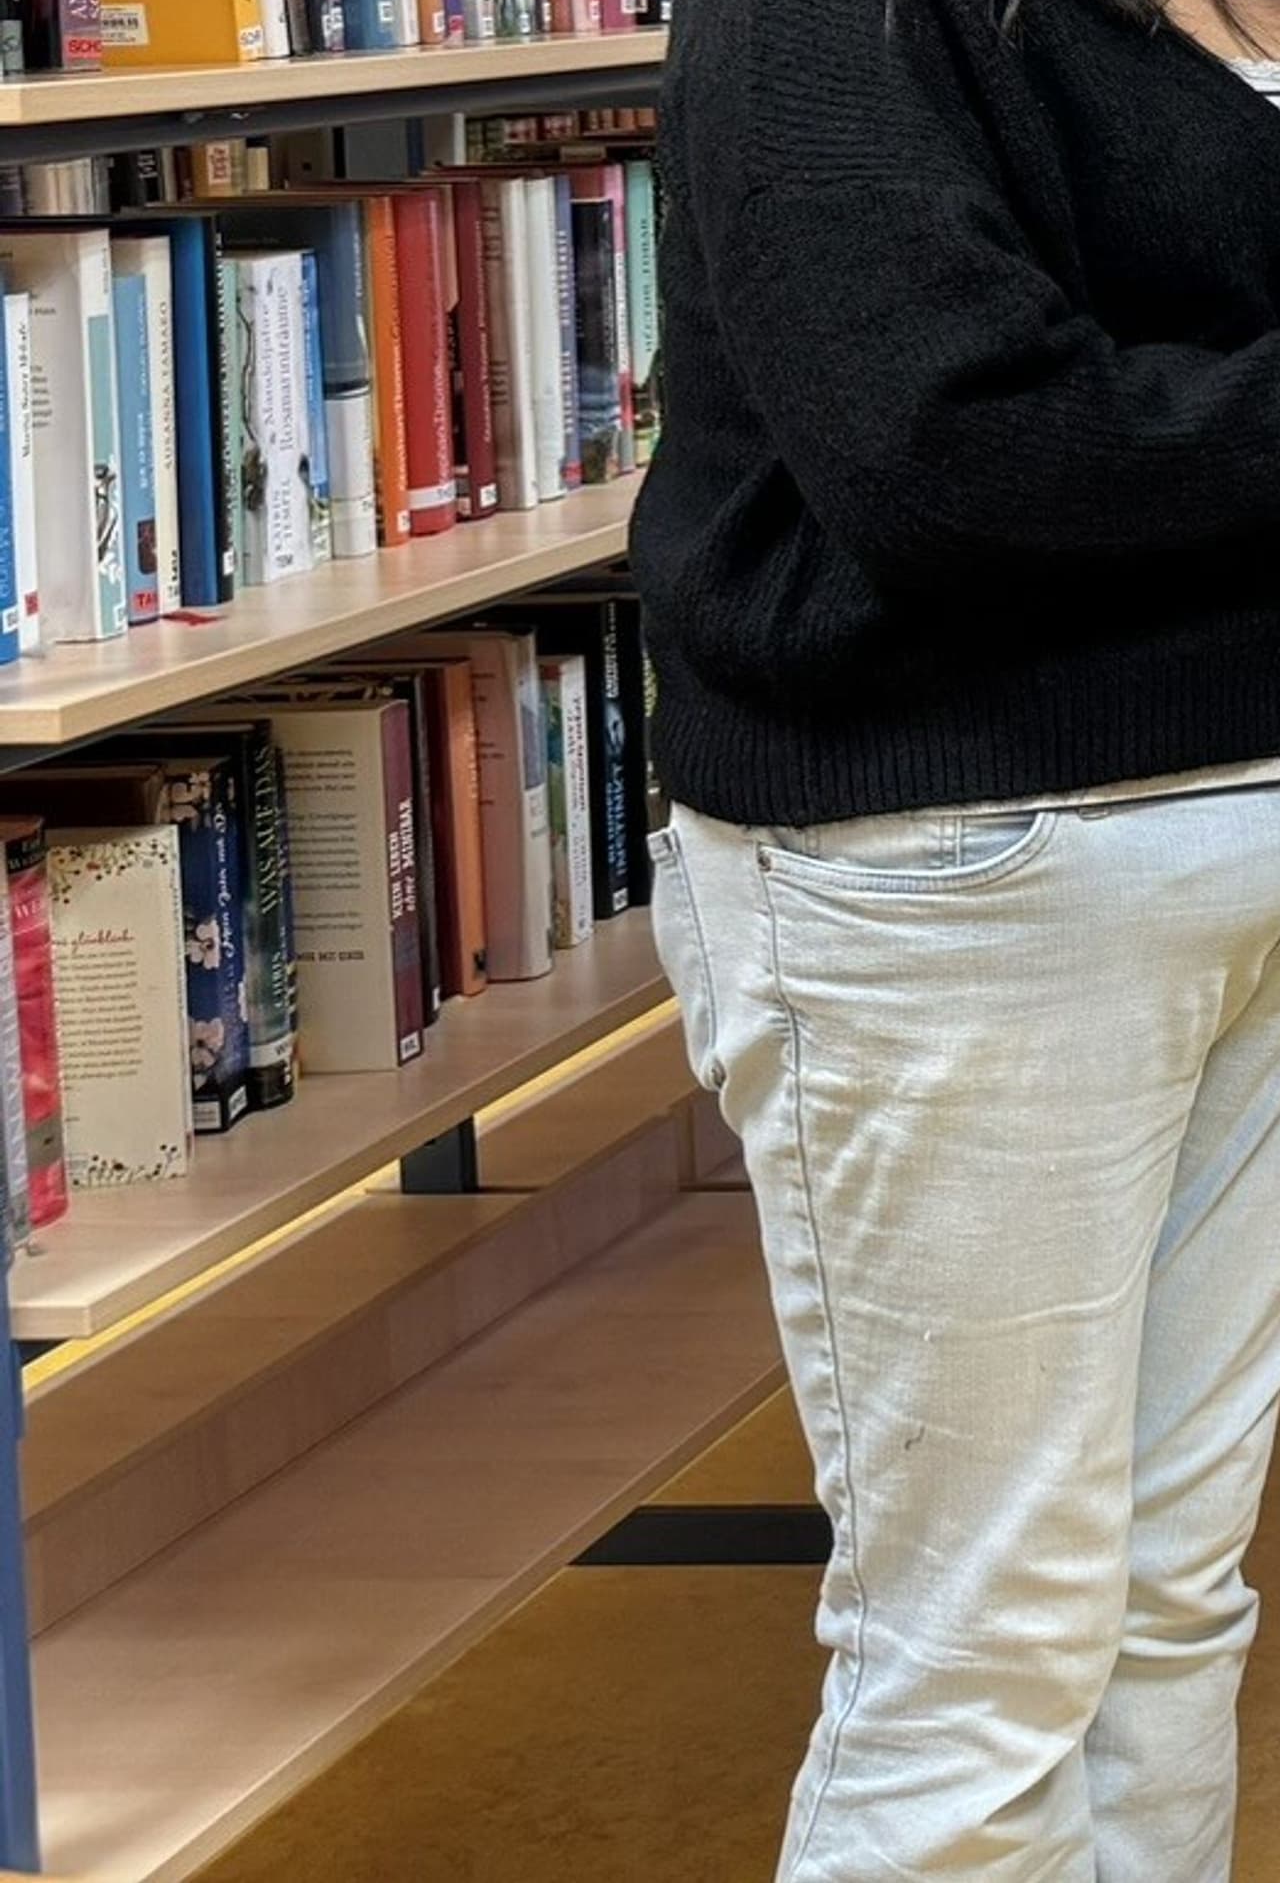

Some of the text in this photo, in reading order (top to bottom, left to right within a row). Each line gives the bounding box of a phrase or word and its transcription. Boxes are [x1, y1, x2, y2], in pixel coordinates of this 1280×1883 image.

[260, 303, 276, 426] Mandeljahre
[273, 286, 294, 452] Rosmarinträume
[253, 745, 280, 914] WAS AUF DAS
[388, 831, 404, 920] KEIN LEBEN
[399, 797, 415, 868] MINIBAR
[271, 951, 285, 1008] CHRIS
